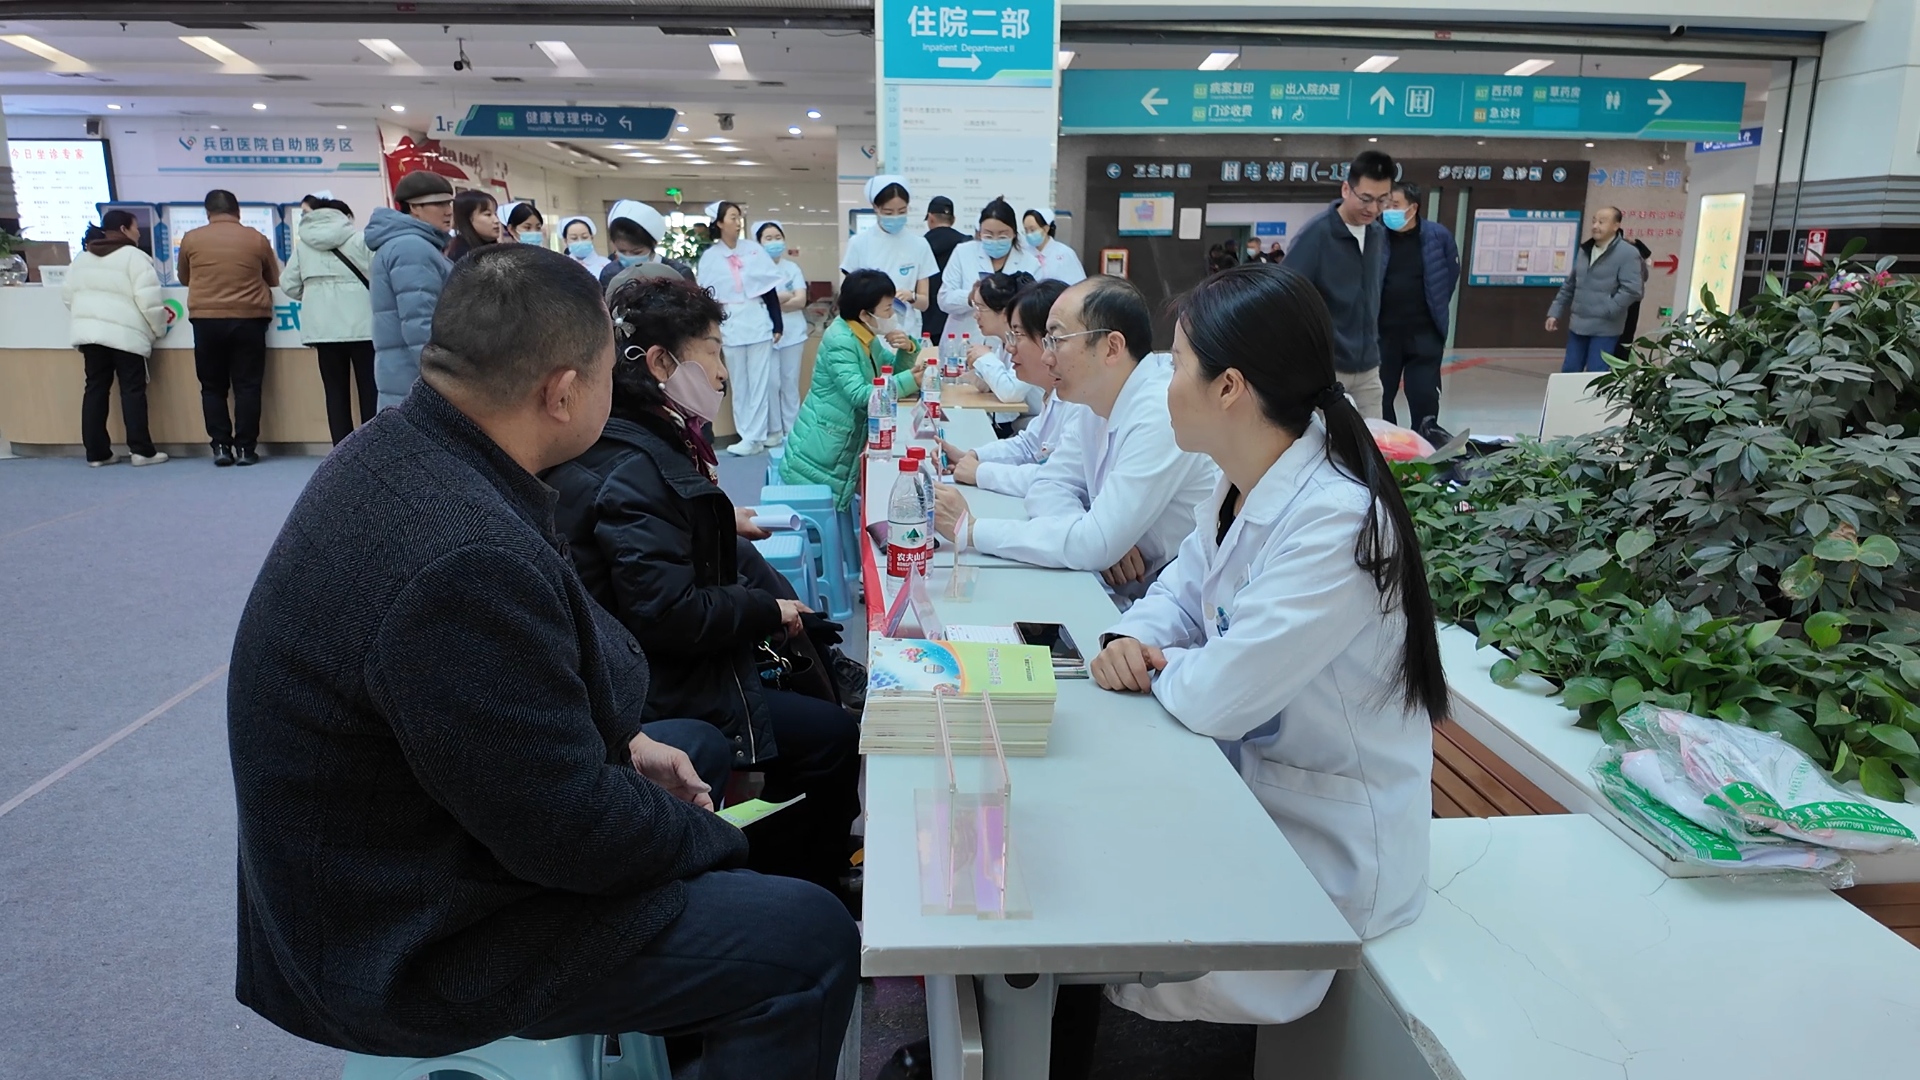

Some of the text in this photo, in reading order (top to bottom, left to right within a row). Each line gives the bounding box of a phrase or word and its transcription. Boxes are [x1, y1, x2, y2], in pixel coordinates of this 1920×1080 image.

[907, 5, 1030, 39] 住院二部
[922, 43, 958, 53] Inpatient
[961, 43, 1008, 54] Department
[1210, 82, 1254, 95] 病案复印
[1285, 83, 1340, 96] 出入院办理
[1491, 85, 1523, 97] 西药房
[1550, 86, 1581, 98] 草药房
[1208, 104, 1253, 117] 门诊收费
[1489, 107, 1521, 119] 急诊科
[436, 115, 454, 132] 1F
[499, 114, 514, 127] A16
[525, 110, 607, 126] 健康管理中心
[203, 137, 354, 151] 兵团医院自助服务区
[11, 148, 84, 160] 今日坐诊专家
[1133, 164, 1175, 178] 卫生间
[1438, 165, 1477, 180] 步行梯
[1502, 165, 1528, 180] 急诊
[1611, 169, 1681, 189] 住院二部
